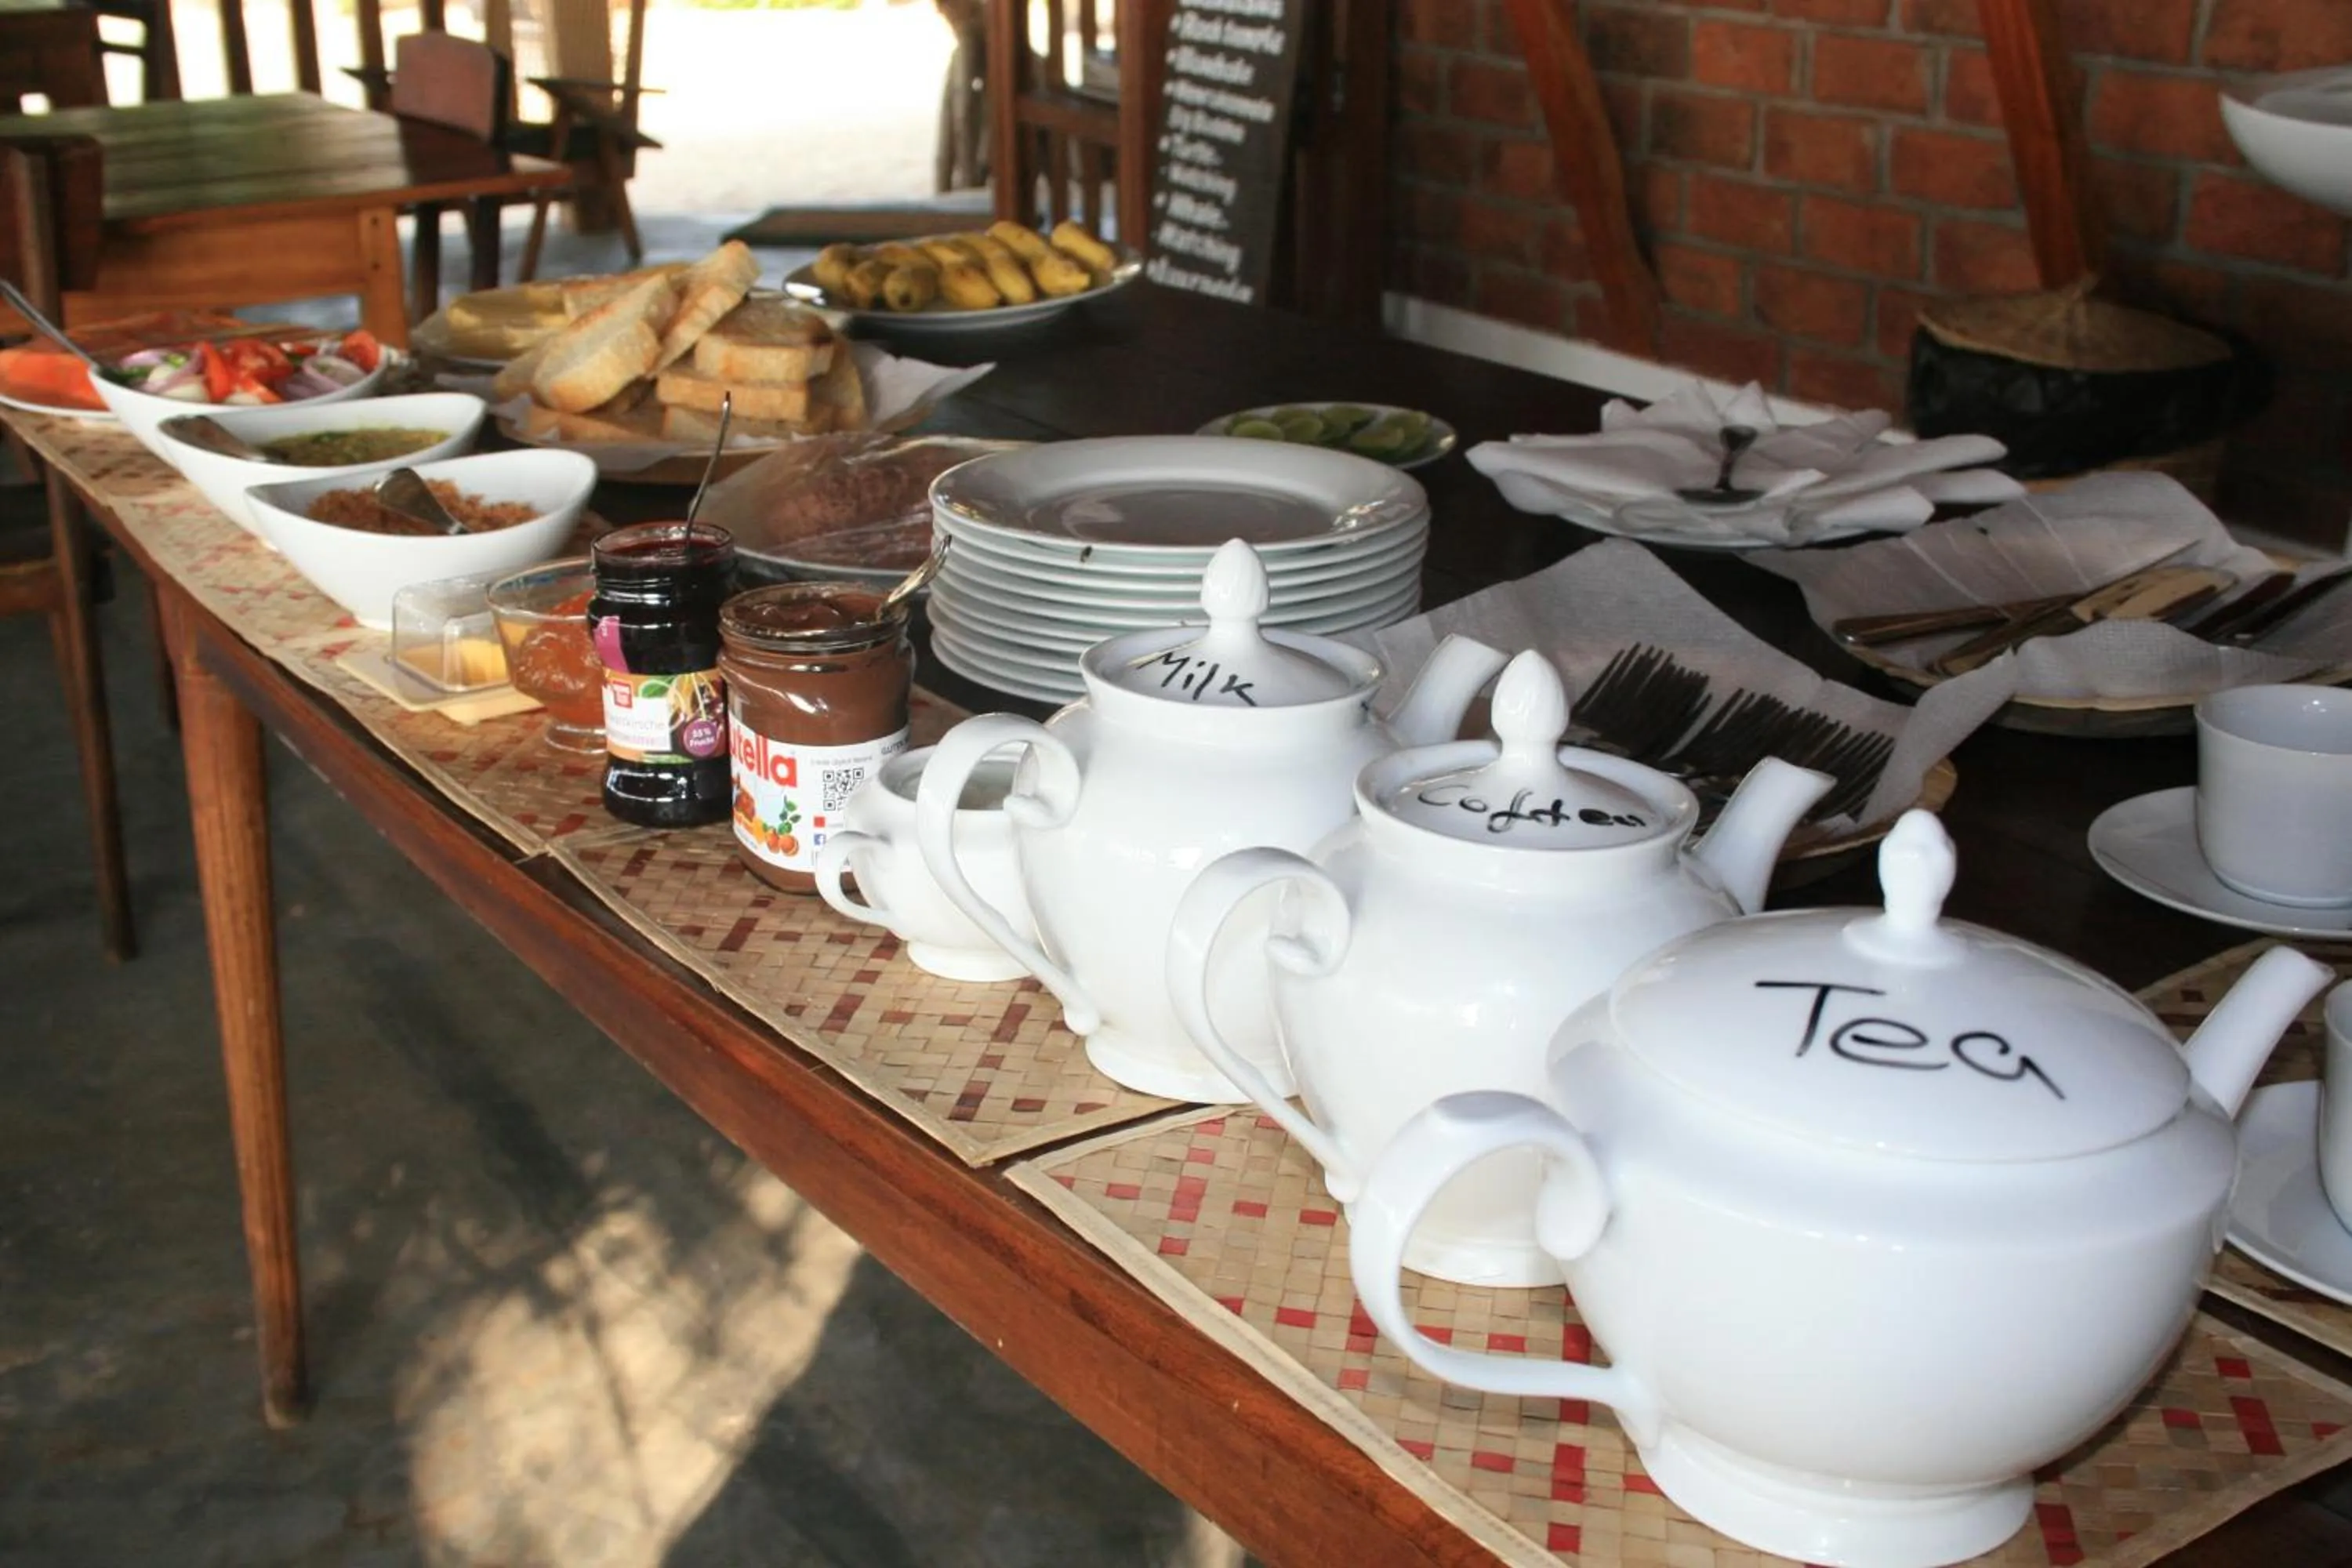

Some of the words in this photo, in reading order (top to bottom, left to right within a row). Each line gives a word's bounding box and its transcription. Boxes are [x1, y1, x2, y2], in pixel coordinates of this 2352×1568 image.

[1136, 652, 1258, 706] Milk
[730, 726, 797, 788] utella
[1755, 981, 2067, 1101] Tea
